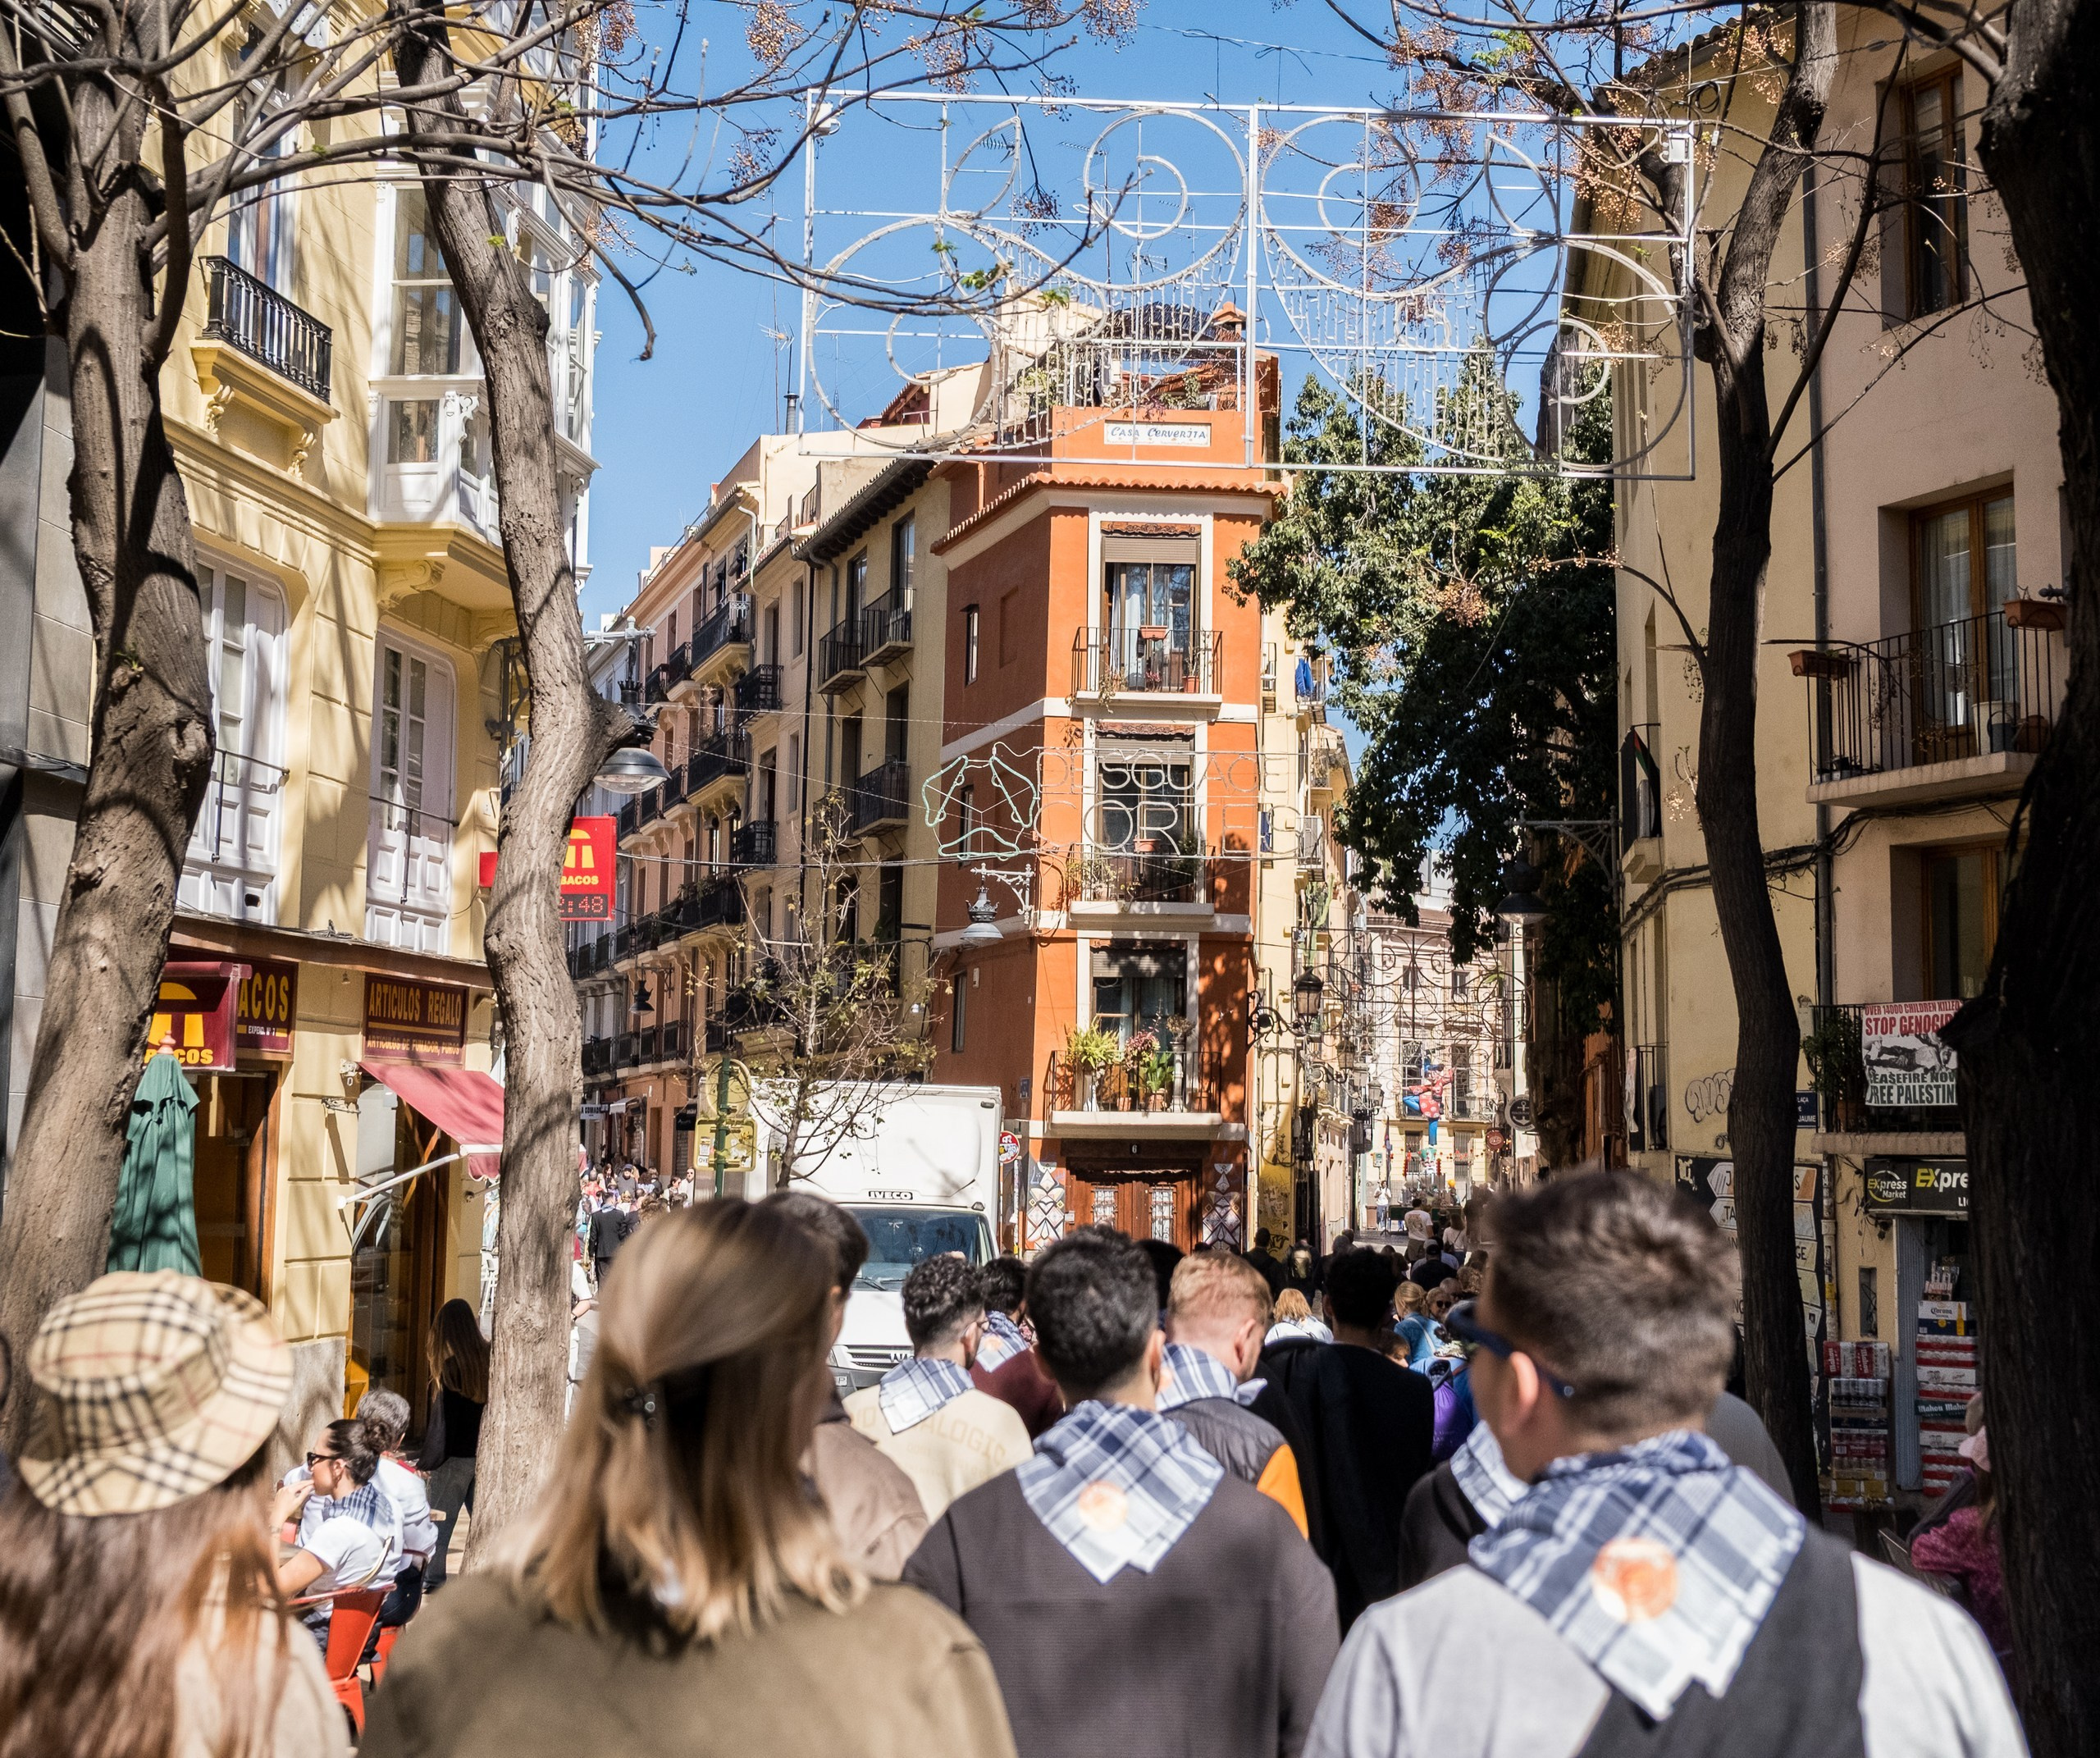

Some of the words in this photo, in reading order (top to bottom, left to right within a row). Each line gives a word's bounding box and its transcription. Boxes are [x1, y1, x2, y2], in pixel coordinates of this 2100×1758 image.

[560, 875, 599, 885] BACOS
[238, 972, 290, 1022] ACOS
[368, 983, 421, 1022] ARTICULOS
[427, 990, 462, 1026] REGALO
[1865, 1004, 1882, 1016] OVER
[1883, 1003, 1903, 1015] 14000
[1904, 1002, 1937, 1014] CHILDREN
[1938, 1000, 1960, 1011] KILLED
[1865, 1016, 1897, 1036] STOP
[1899, 1013, 1955, 1035] GENOCID
[402, 1038, 410, 1051] DE
[1796, 1096, 1810, 1104] LAÇA
[1897, 1084, 1955, 1104] PALESTIN
[1131, 1144, 1138, 1154] 6
[1915, 1167, 1969, 1192] EXpre
[868, 1190, 913, 1200] IVECO
[1882, 1190, 1906, 1199] Market
[1957, 1196, 1969, 1207] LI
[1918, 1404, 1943, 1413] Mahou
[1944, 1403, 1966, 1412] Maho
